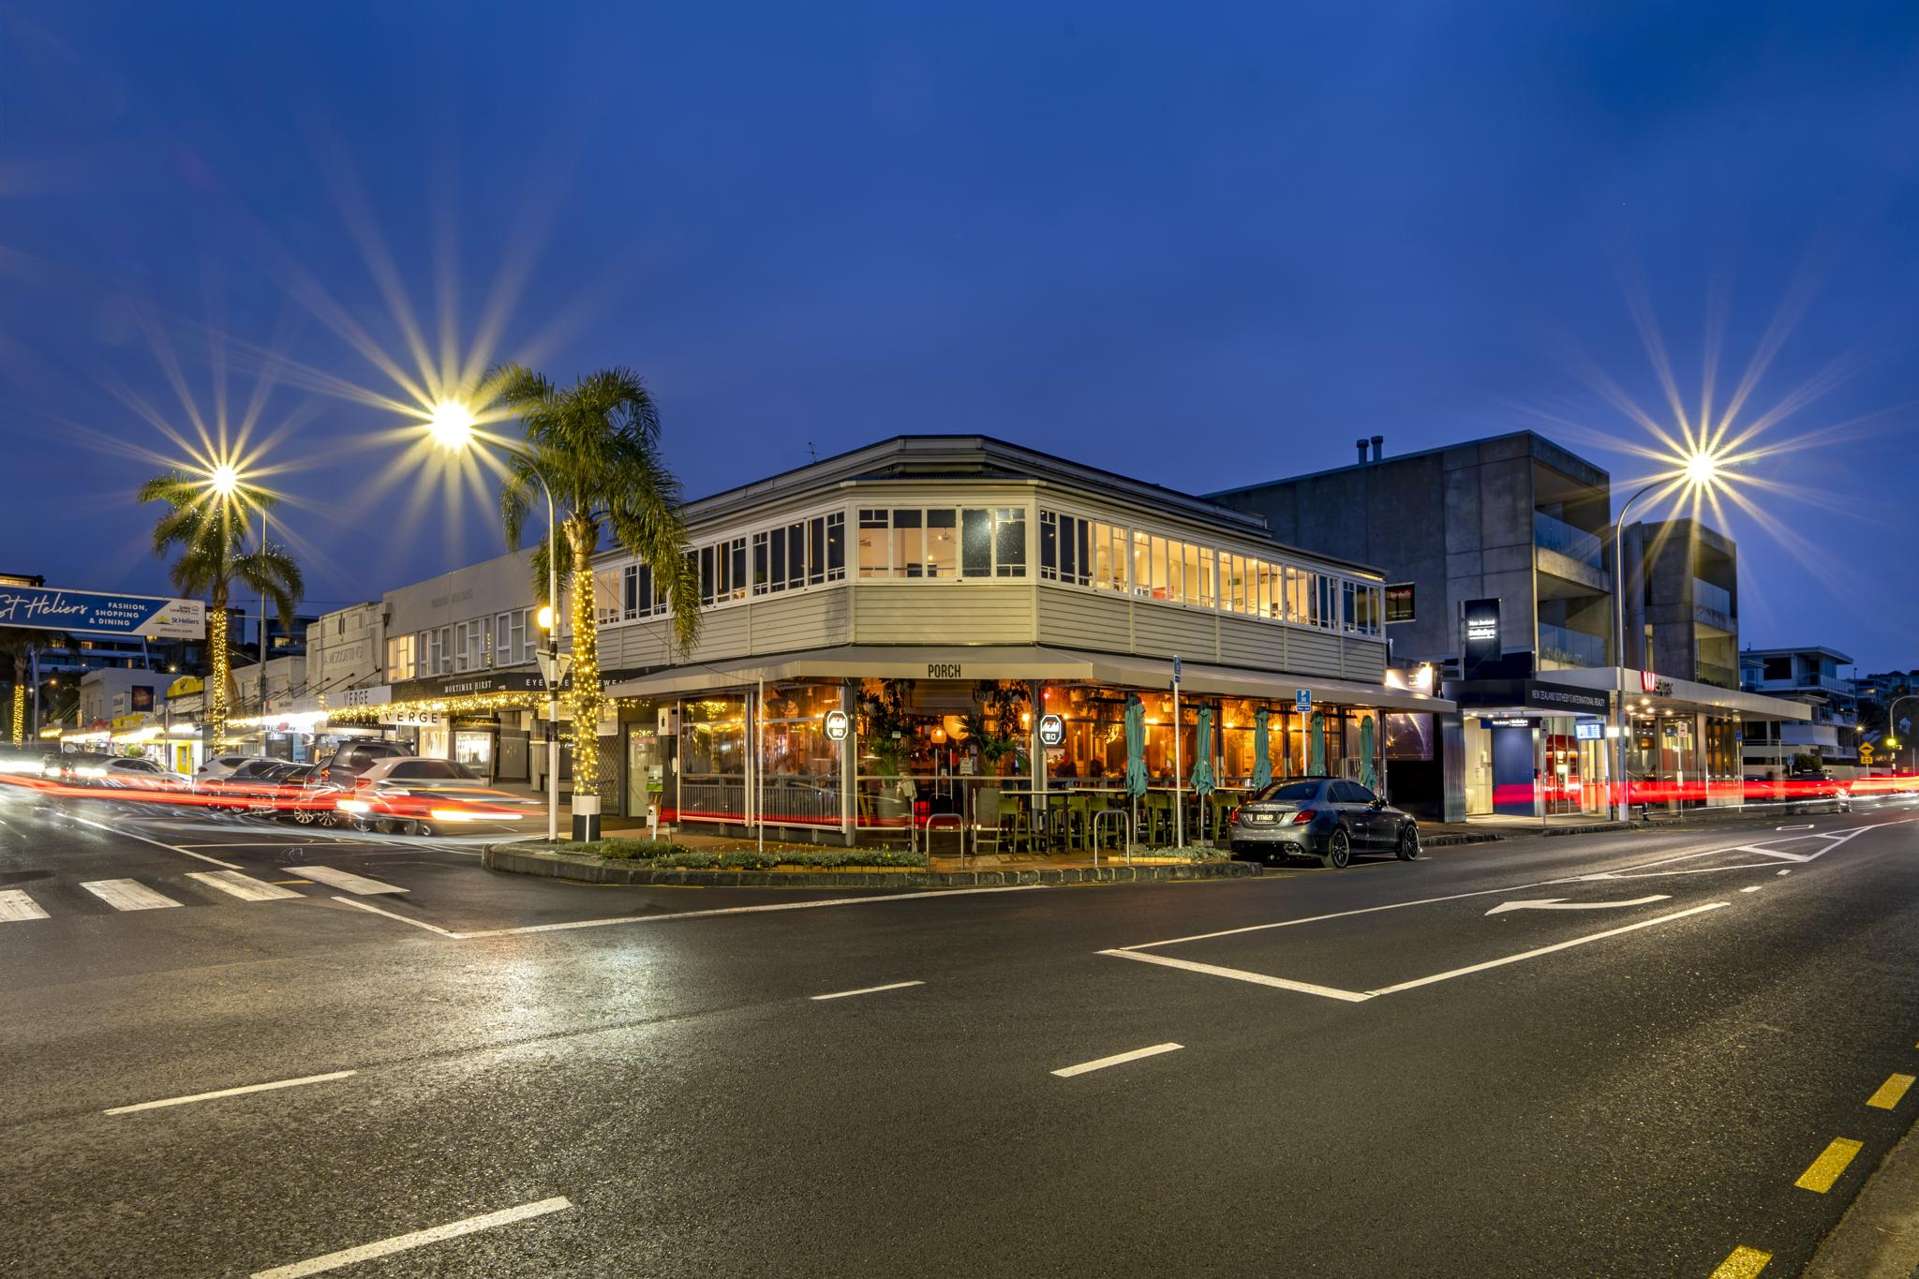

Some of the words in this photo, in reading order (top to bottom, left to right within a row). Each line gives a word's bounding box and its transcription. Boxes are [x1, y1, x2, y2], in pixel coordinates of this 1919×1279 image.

[24, 592, 88, 618] Heliers
[95, 609, 140, 619] SHOPPING
[89, 617, 96, 625] &
[98, 618, 131, 626] DINING
[928, 664, 961, 678] PORCH
[344, 690, 368, 706] VERGE
[386, 711, 438, 723] VERGE
